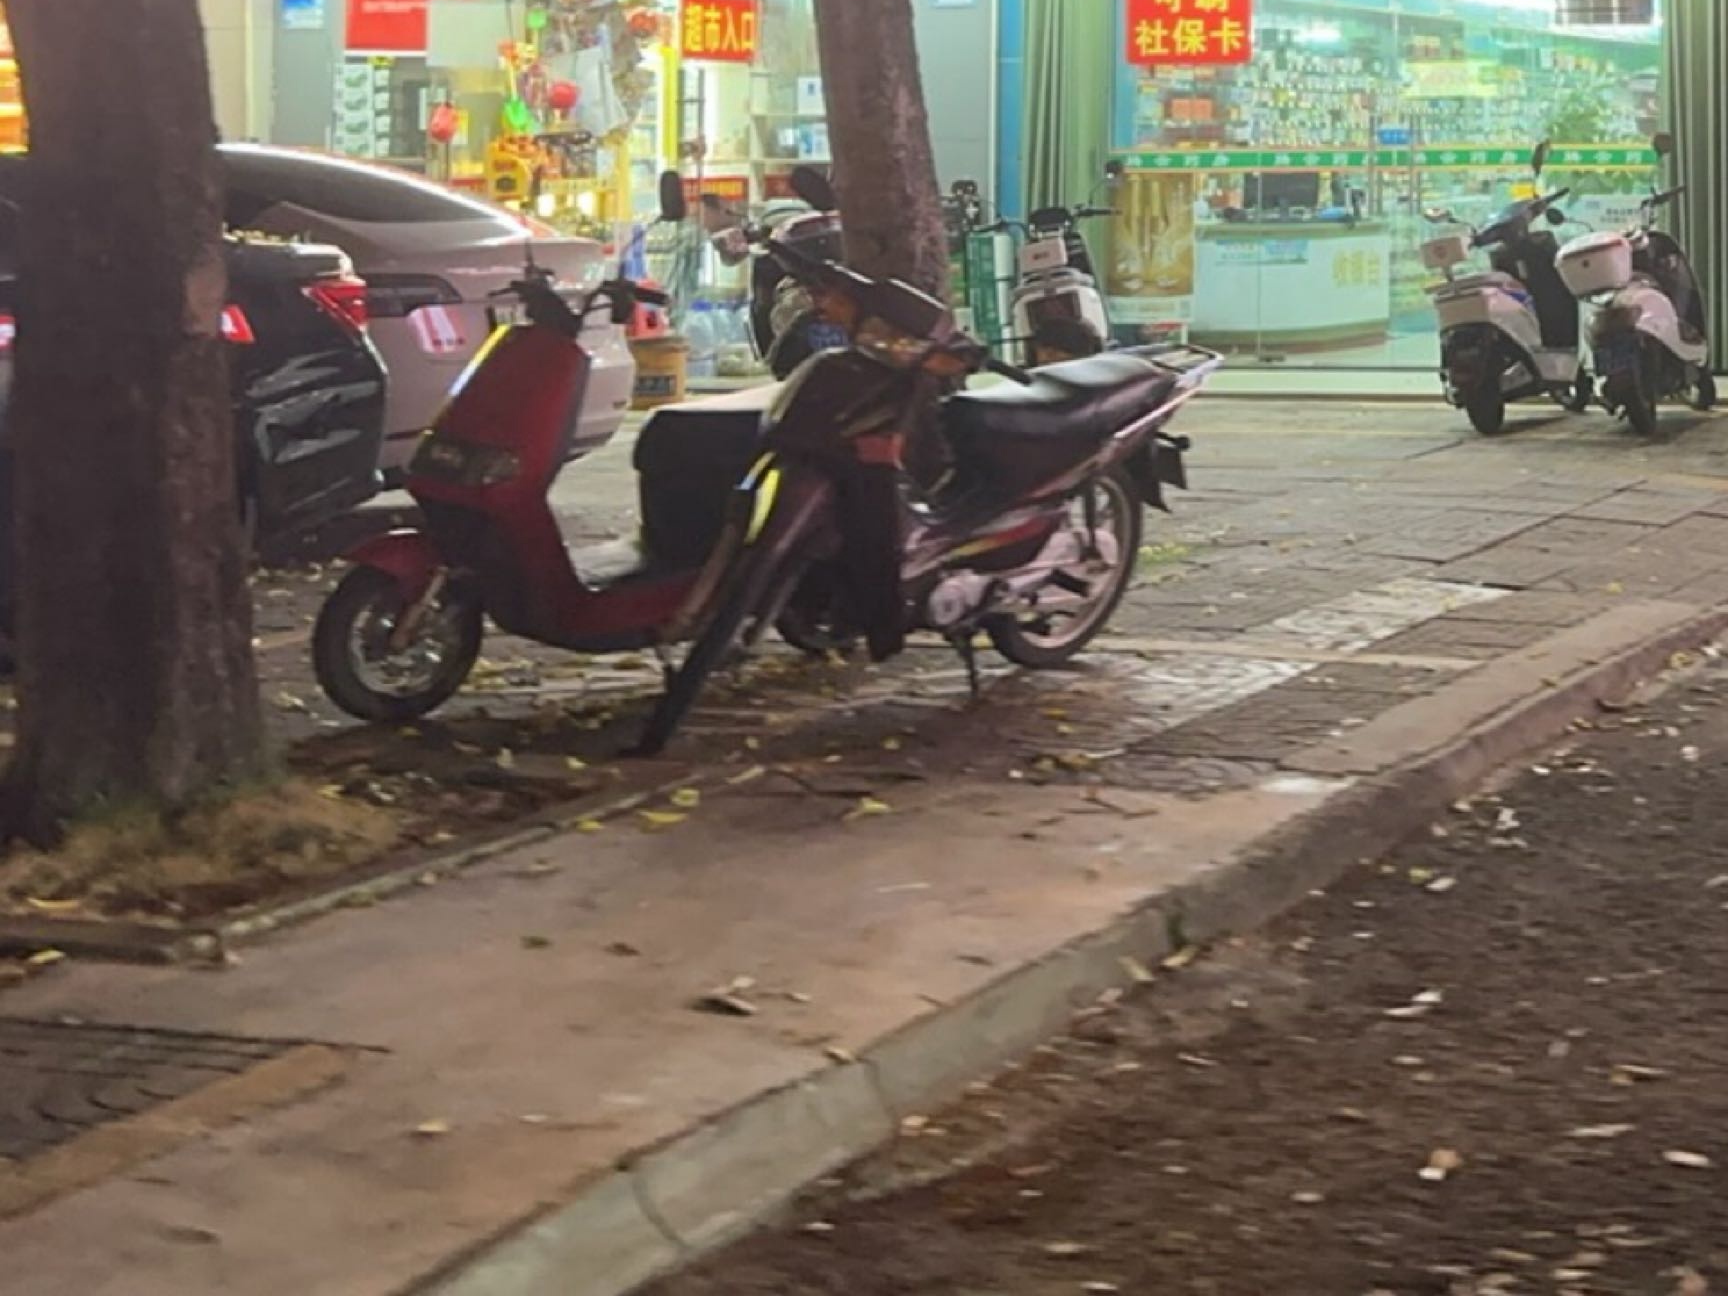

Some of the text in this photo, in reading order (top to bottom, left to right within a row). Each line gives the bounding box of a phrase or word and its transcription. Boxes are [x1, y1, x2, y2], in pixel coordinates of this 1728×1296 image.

[685, 1, 756, 52] 超市入口
[1135, 20, 1246, 58] 社保卡
